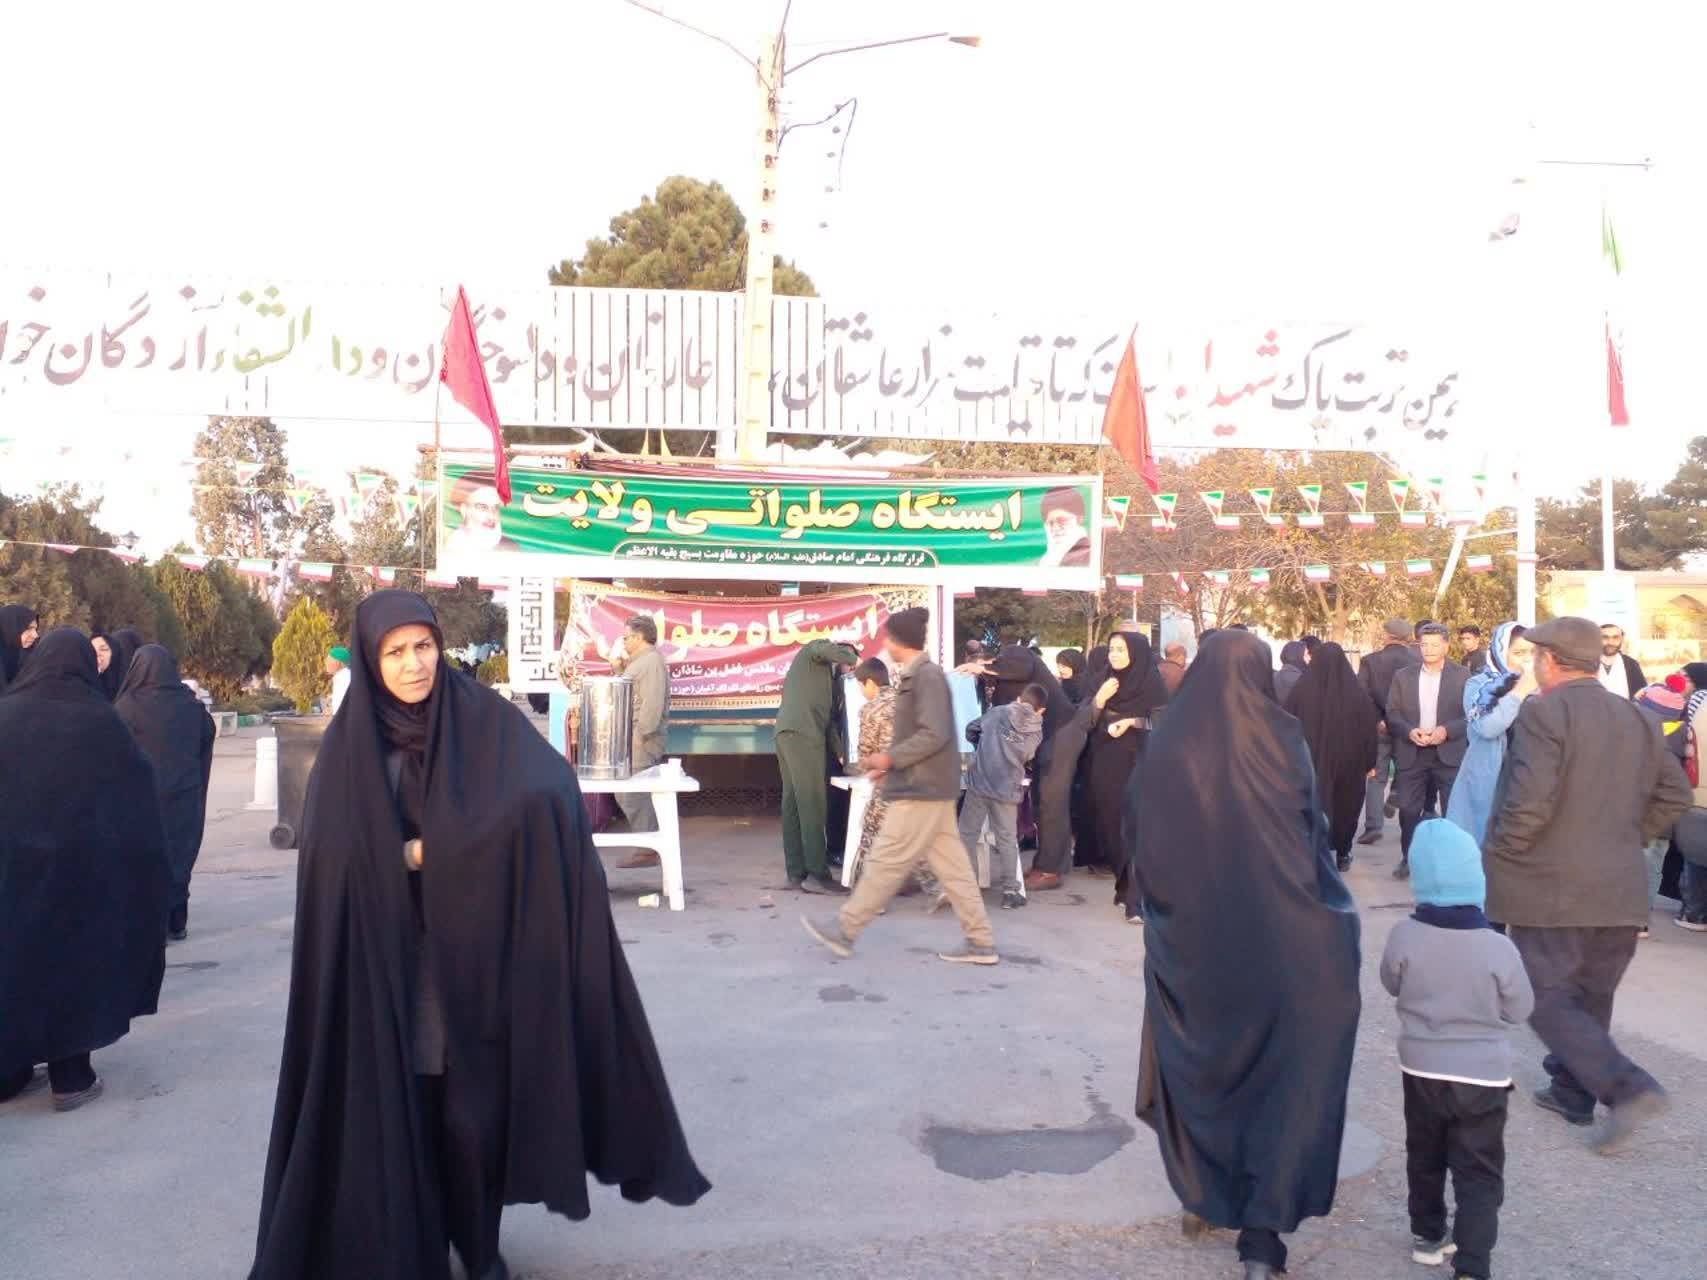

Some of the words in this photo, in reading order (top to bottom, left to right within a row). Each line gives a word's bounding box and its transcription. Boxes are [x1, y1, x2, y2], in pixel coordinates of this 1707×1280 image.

[522, 480, 654, 535] ولایت
[665, 488, 861, 540] صلواتی
[872, 489, 1023, 540] ایستگاه
[836, 551, 855, 563] امام
[856, 552, 891, 566] فرهنگی
[892, 551, 925, 566] قرارگاه
[746, 603, 878, 652] ایستگاه
